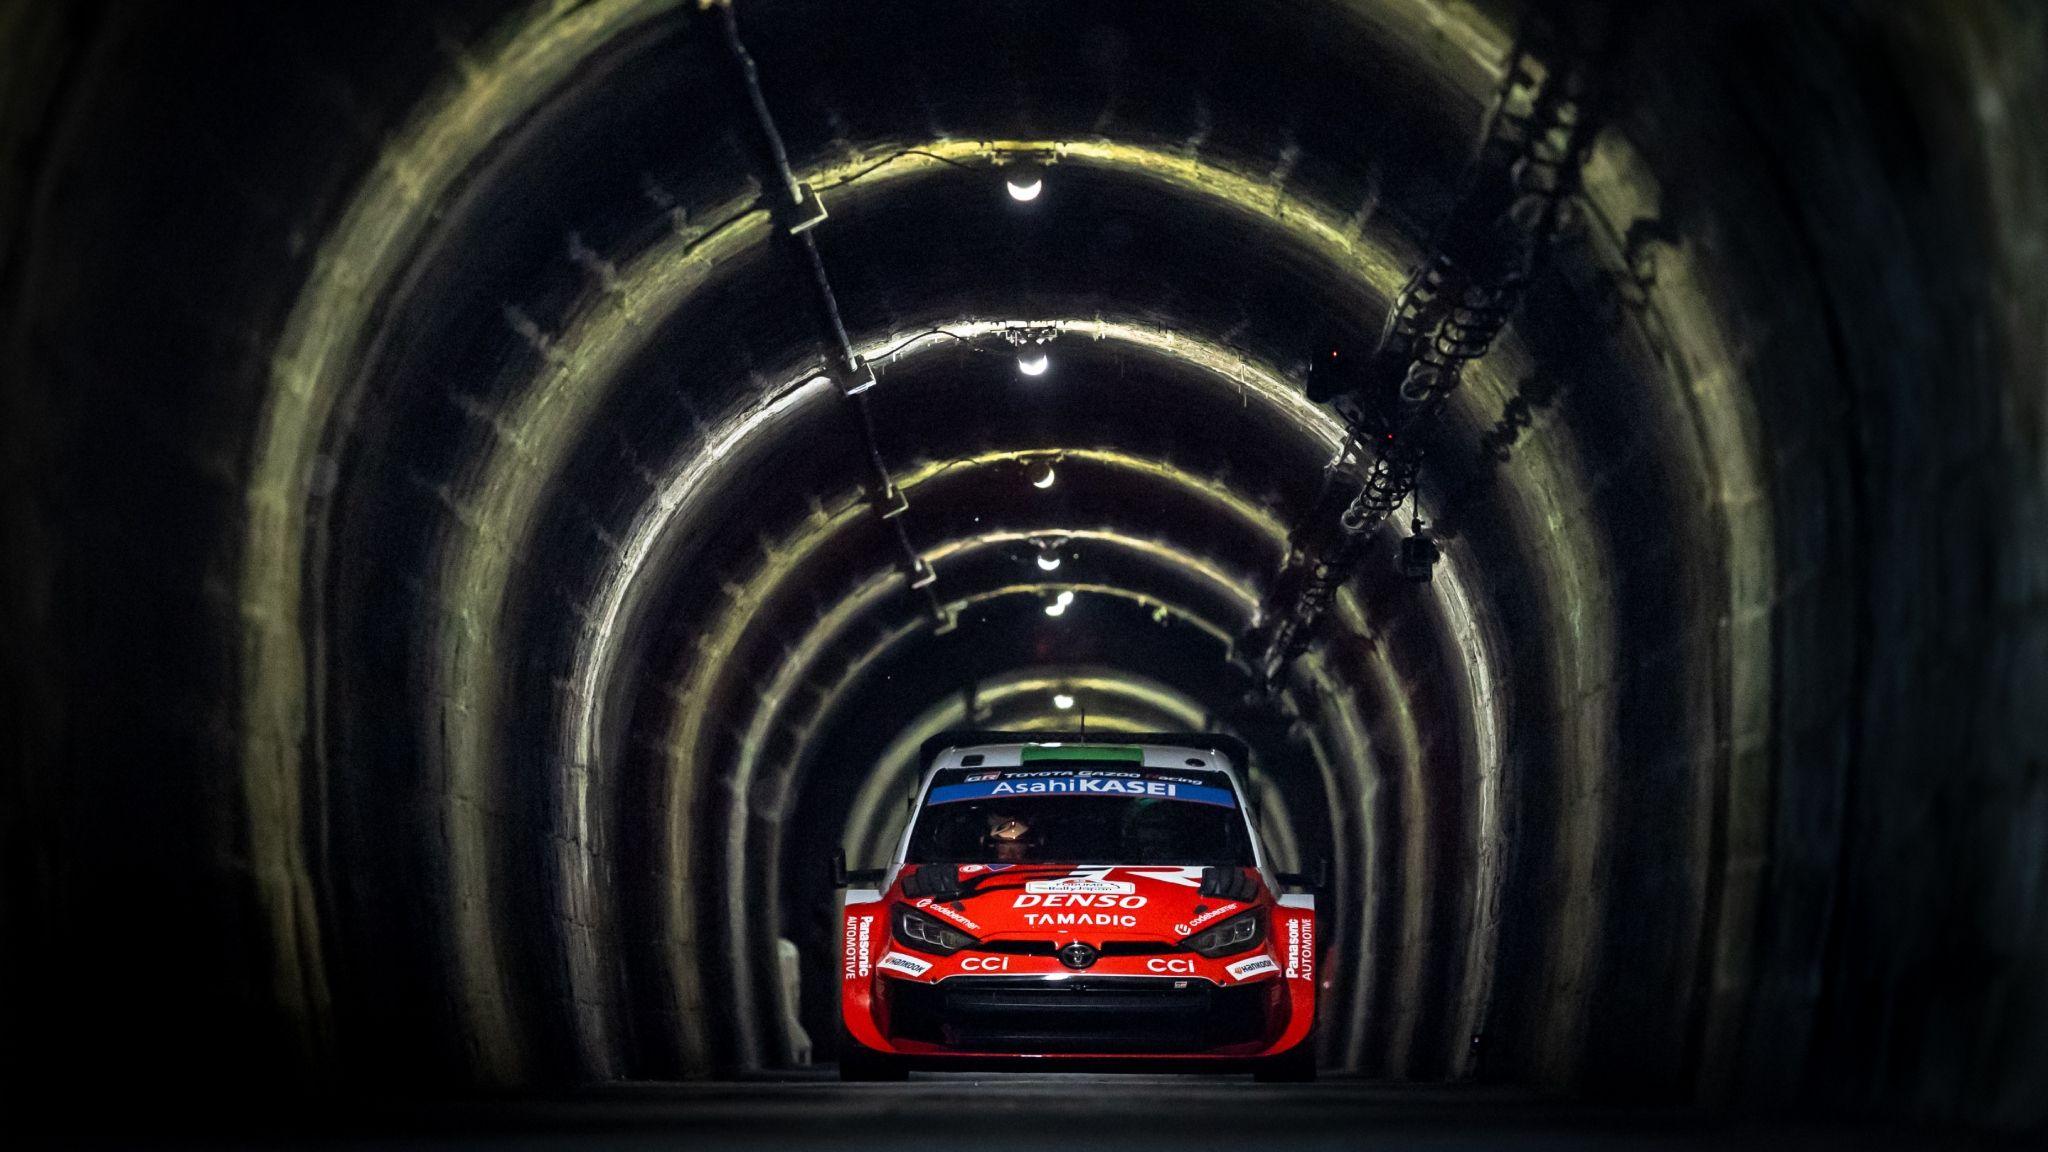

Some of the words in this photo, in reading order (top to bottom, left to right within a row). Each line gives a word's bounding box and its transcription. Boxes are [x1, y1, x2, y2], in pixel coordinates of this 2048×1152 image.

[1078, 770, 1140, 778] GAZOO
[1012, 894, 1148, 909] DENSO
[1024, 913, 1137, 927] TAMADIC
[846, 916, 857, 979] AUTOMOTIVE
[859, 916, 873, 977] Panasonic
[1286, 919, 1299, 979] Panasonic
[1302, 919, 1312, 981] AUTOMOTIVE
[961, 957, 1009, 971] CCI
[1147, 958, 1195, 973] CCI
